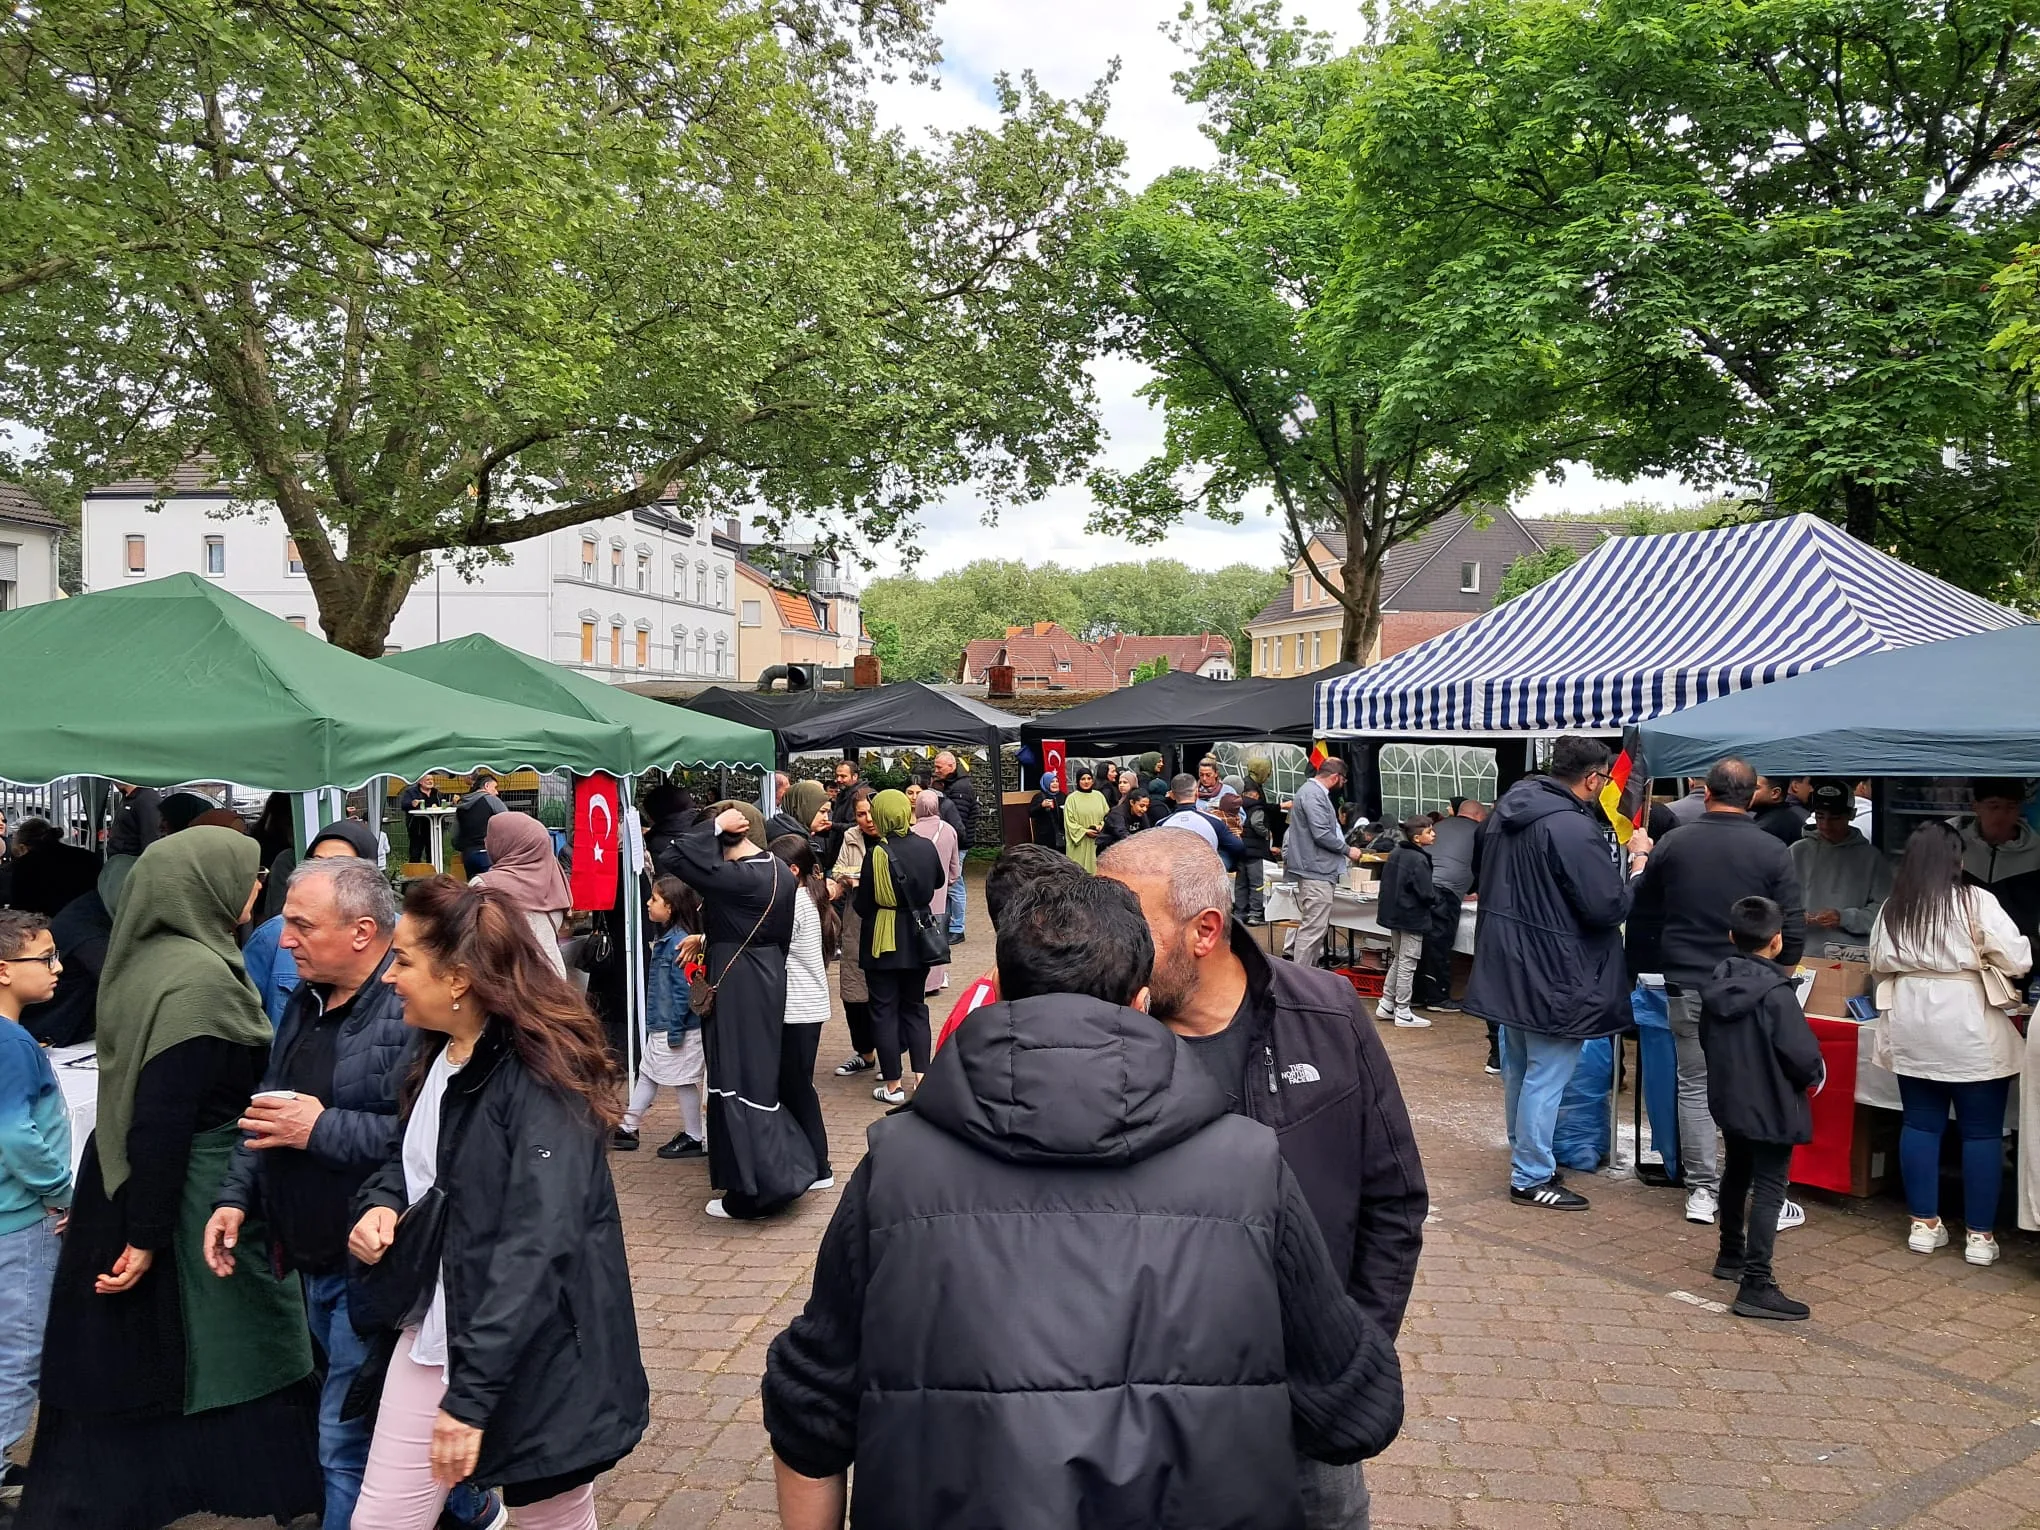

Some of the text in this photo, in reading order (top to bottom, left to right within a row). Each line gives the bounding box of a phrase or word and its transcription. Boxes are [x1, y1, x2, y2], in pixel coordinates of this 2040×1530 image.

[1288, 1064, 1304, 1072] THE
[1281, 1070, 1306, 1079] NORTH
[1289, 1077, 1307, 1085] FACE
